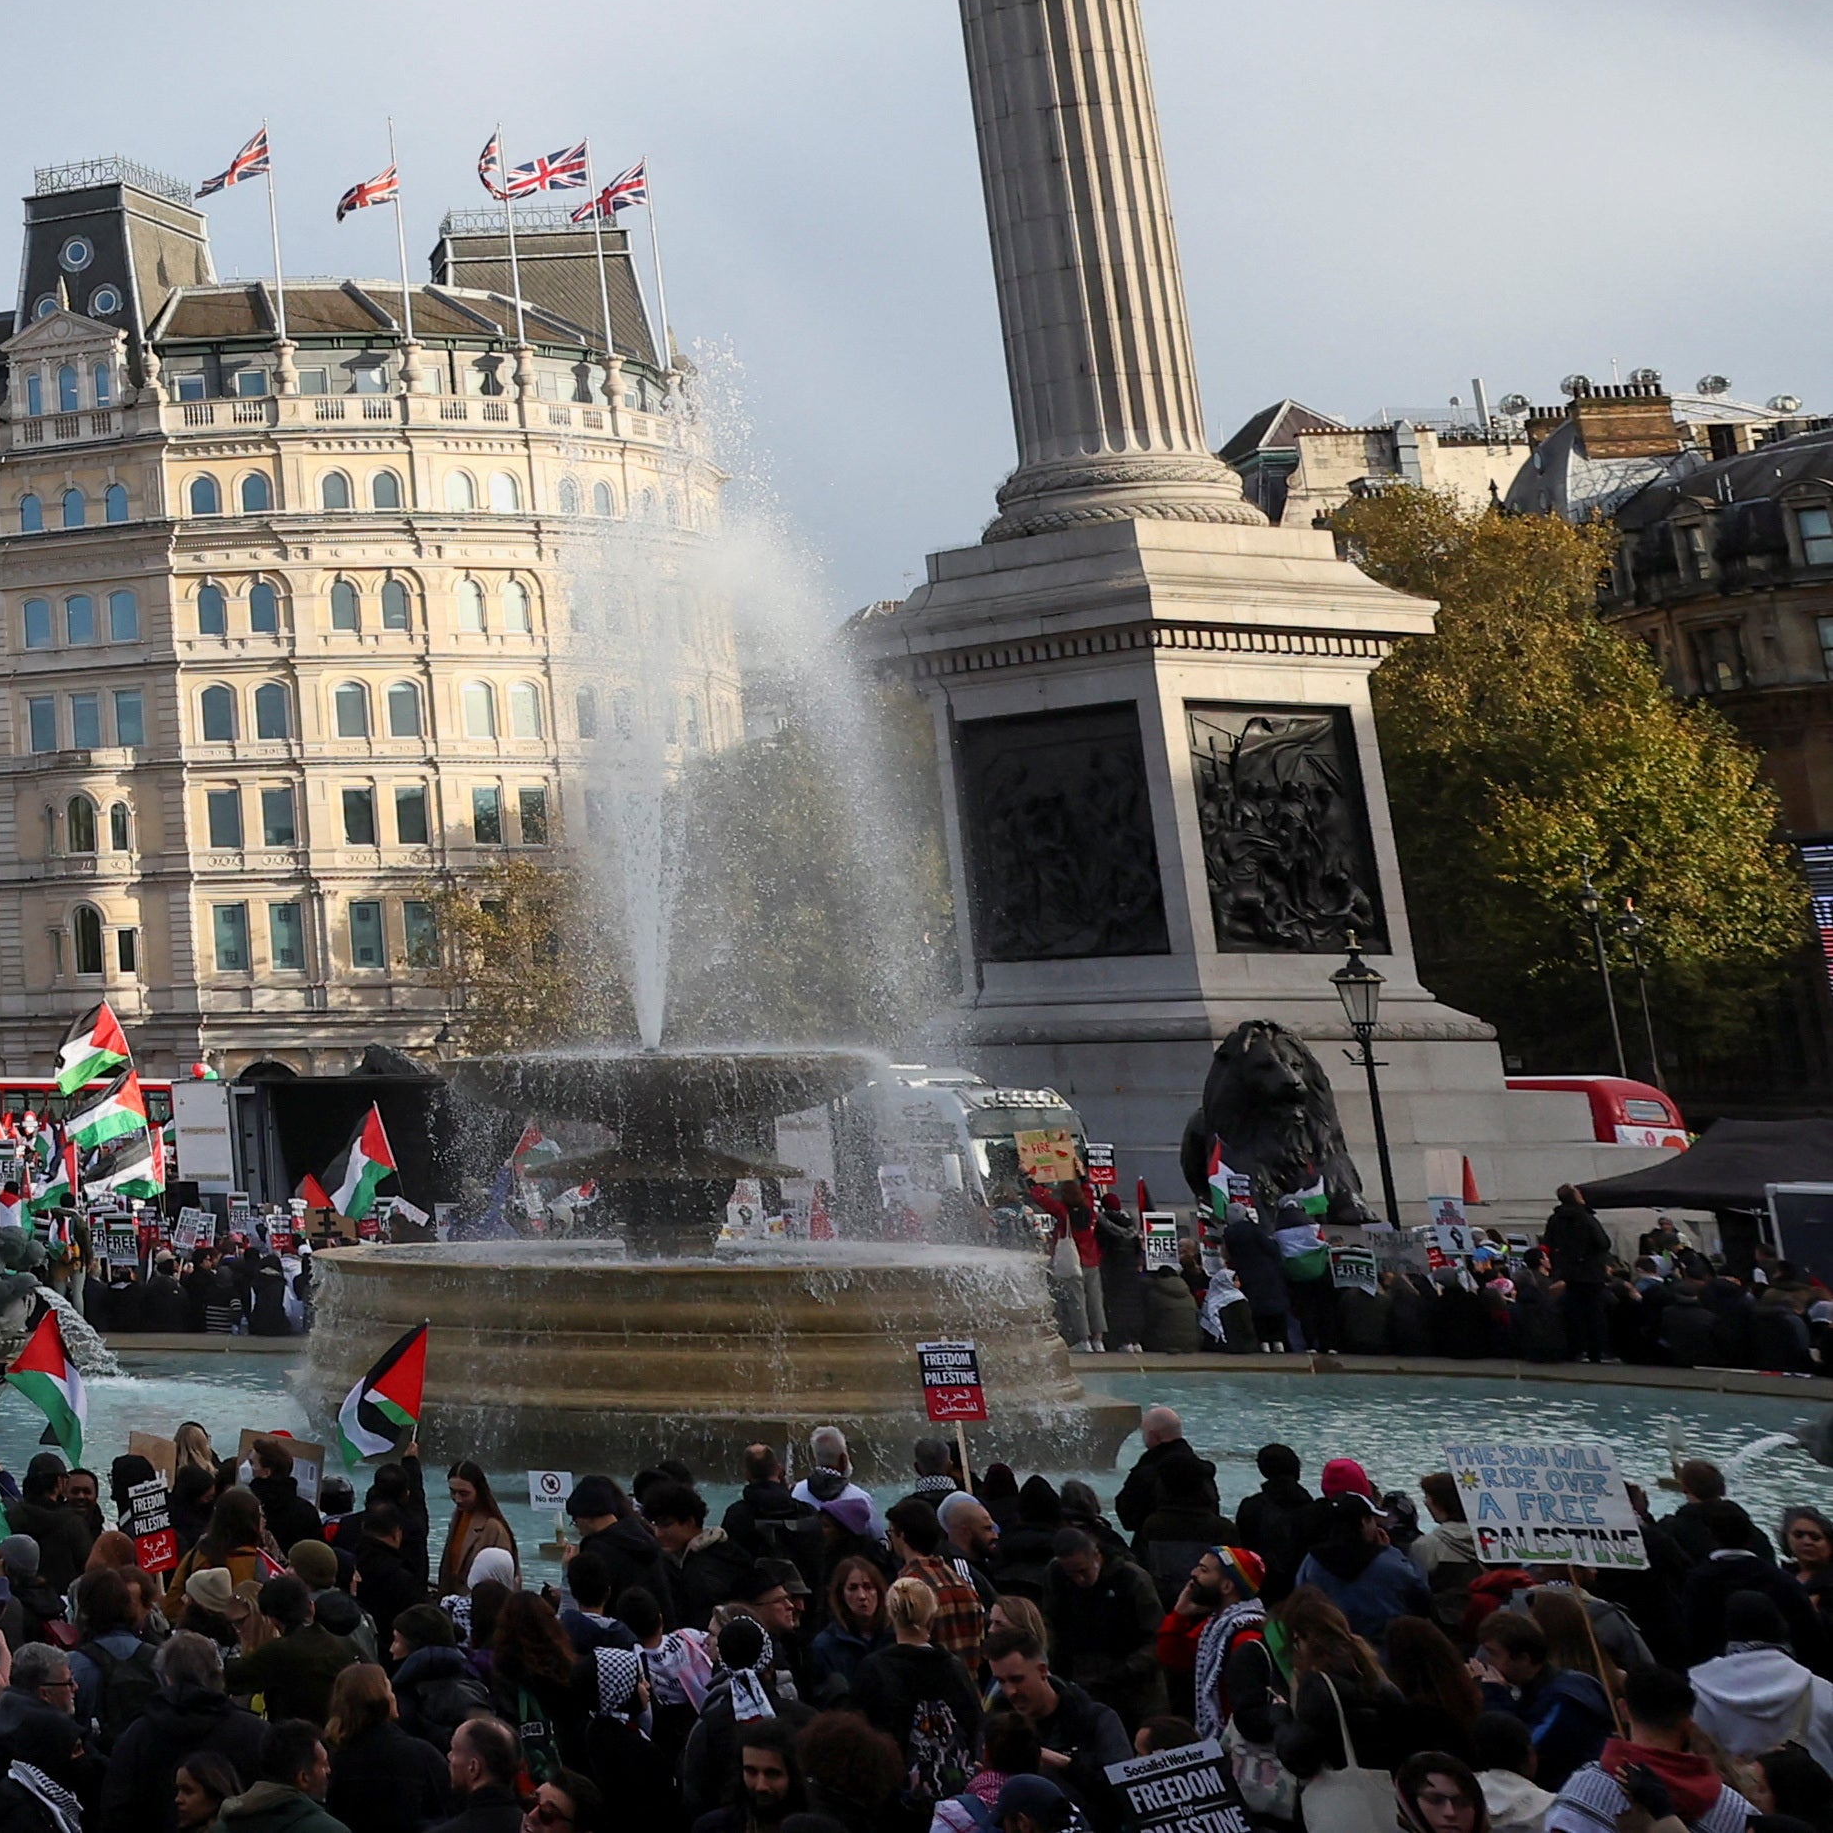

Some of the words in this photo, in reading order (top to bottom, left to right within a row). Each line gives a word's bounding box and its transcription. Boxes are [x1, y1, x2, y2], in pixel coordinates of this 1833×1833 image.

[1031, 1142, 1051, 1154] FIRE
[91, 1230, 105, 1242] FR
[107, 1236, 135, 1248] FREE
[1147, 1238, 1177, 1251] FREE
[1334, 1264, 1375, 1278] FREE
[923, 1353, 972, 1366] FREEDOM
[924, 1370, 978, 1385] PALESTINE
[1447, 1447, 1498, 1466] THE
[1501, 1444, 1548, 1467] SUN
[1549, 1447, 1611, 1471] WILL
[1480, 1467, 1540, 1491] RISE
[1546, 1470, 1611, 1496] OVER
[133, 1491, 166, 1514] FREEDOM
[535, 1495, 547, 1503] No
[1478, 1492, 1506, 1520] A
[1516, 1492, 1605, 1524] FREE
[134, 1512, 171, 1535] PALESTINE
[1477, 1526, 1644, 1565] PALESTINE
[1123, 1756, 1167, 1777] Socialist
[1166, 1749, 1204, 1768] Worker
[1126, 1766, 1226, 1814] FREEDOM
[1140, 1806, 1252, 1833] ESTINE
[1177, 1804, 1195, 1817] for
